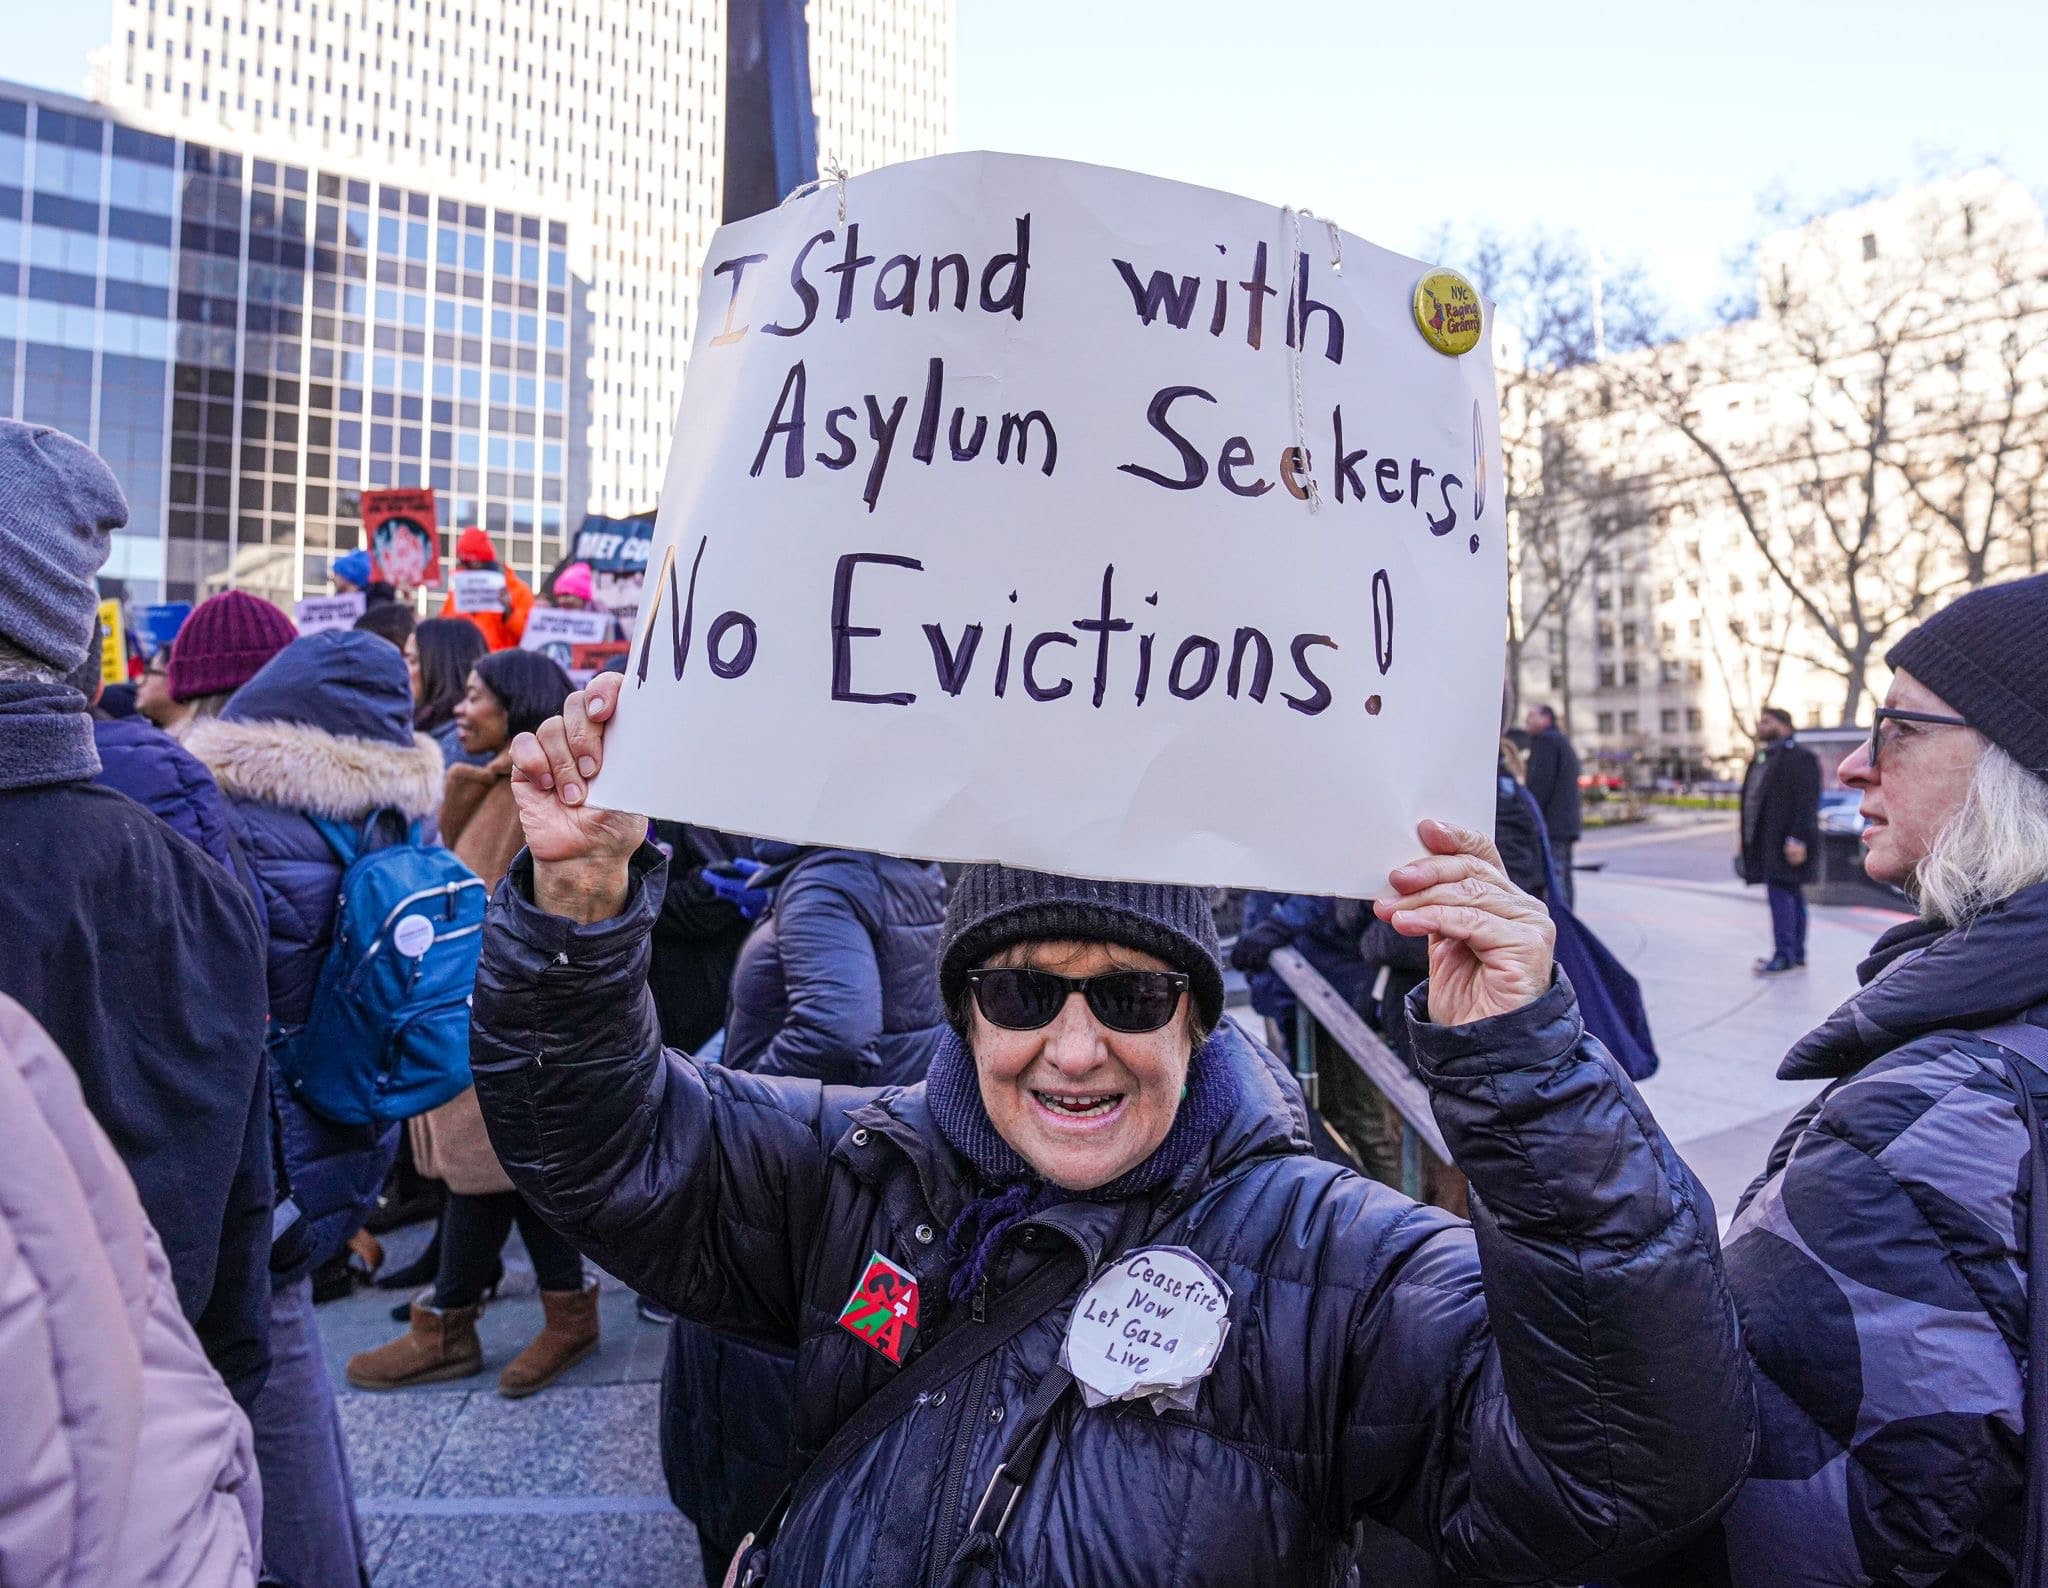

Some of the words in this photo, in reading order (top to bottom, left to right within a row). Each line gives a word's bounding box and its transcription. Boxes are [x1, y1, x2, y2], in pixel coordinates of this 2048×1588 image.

[710, 254, 768, 347] I
[760, 213, 1030, 337] Stand
[1112, 241, 1344, 364] with
[1445, 302, 1479, 319] Raging
[1447, 318, 1480, 334] Granny
[750, 358, 1057, 513] Asylum
[1117, 386, 1487, 553] Seekers!
[637, 535, 757, 689] No
[1126, 1288, 1174, 1319] Now
[1083, 1298, 1119, 1327] Let
[1123, 1318, 1179, 1354] Gaza
[1105, 1341, 1150, 1374] Live
